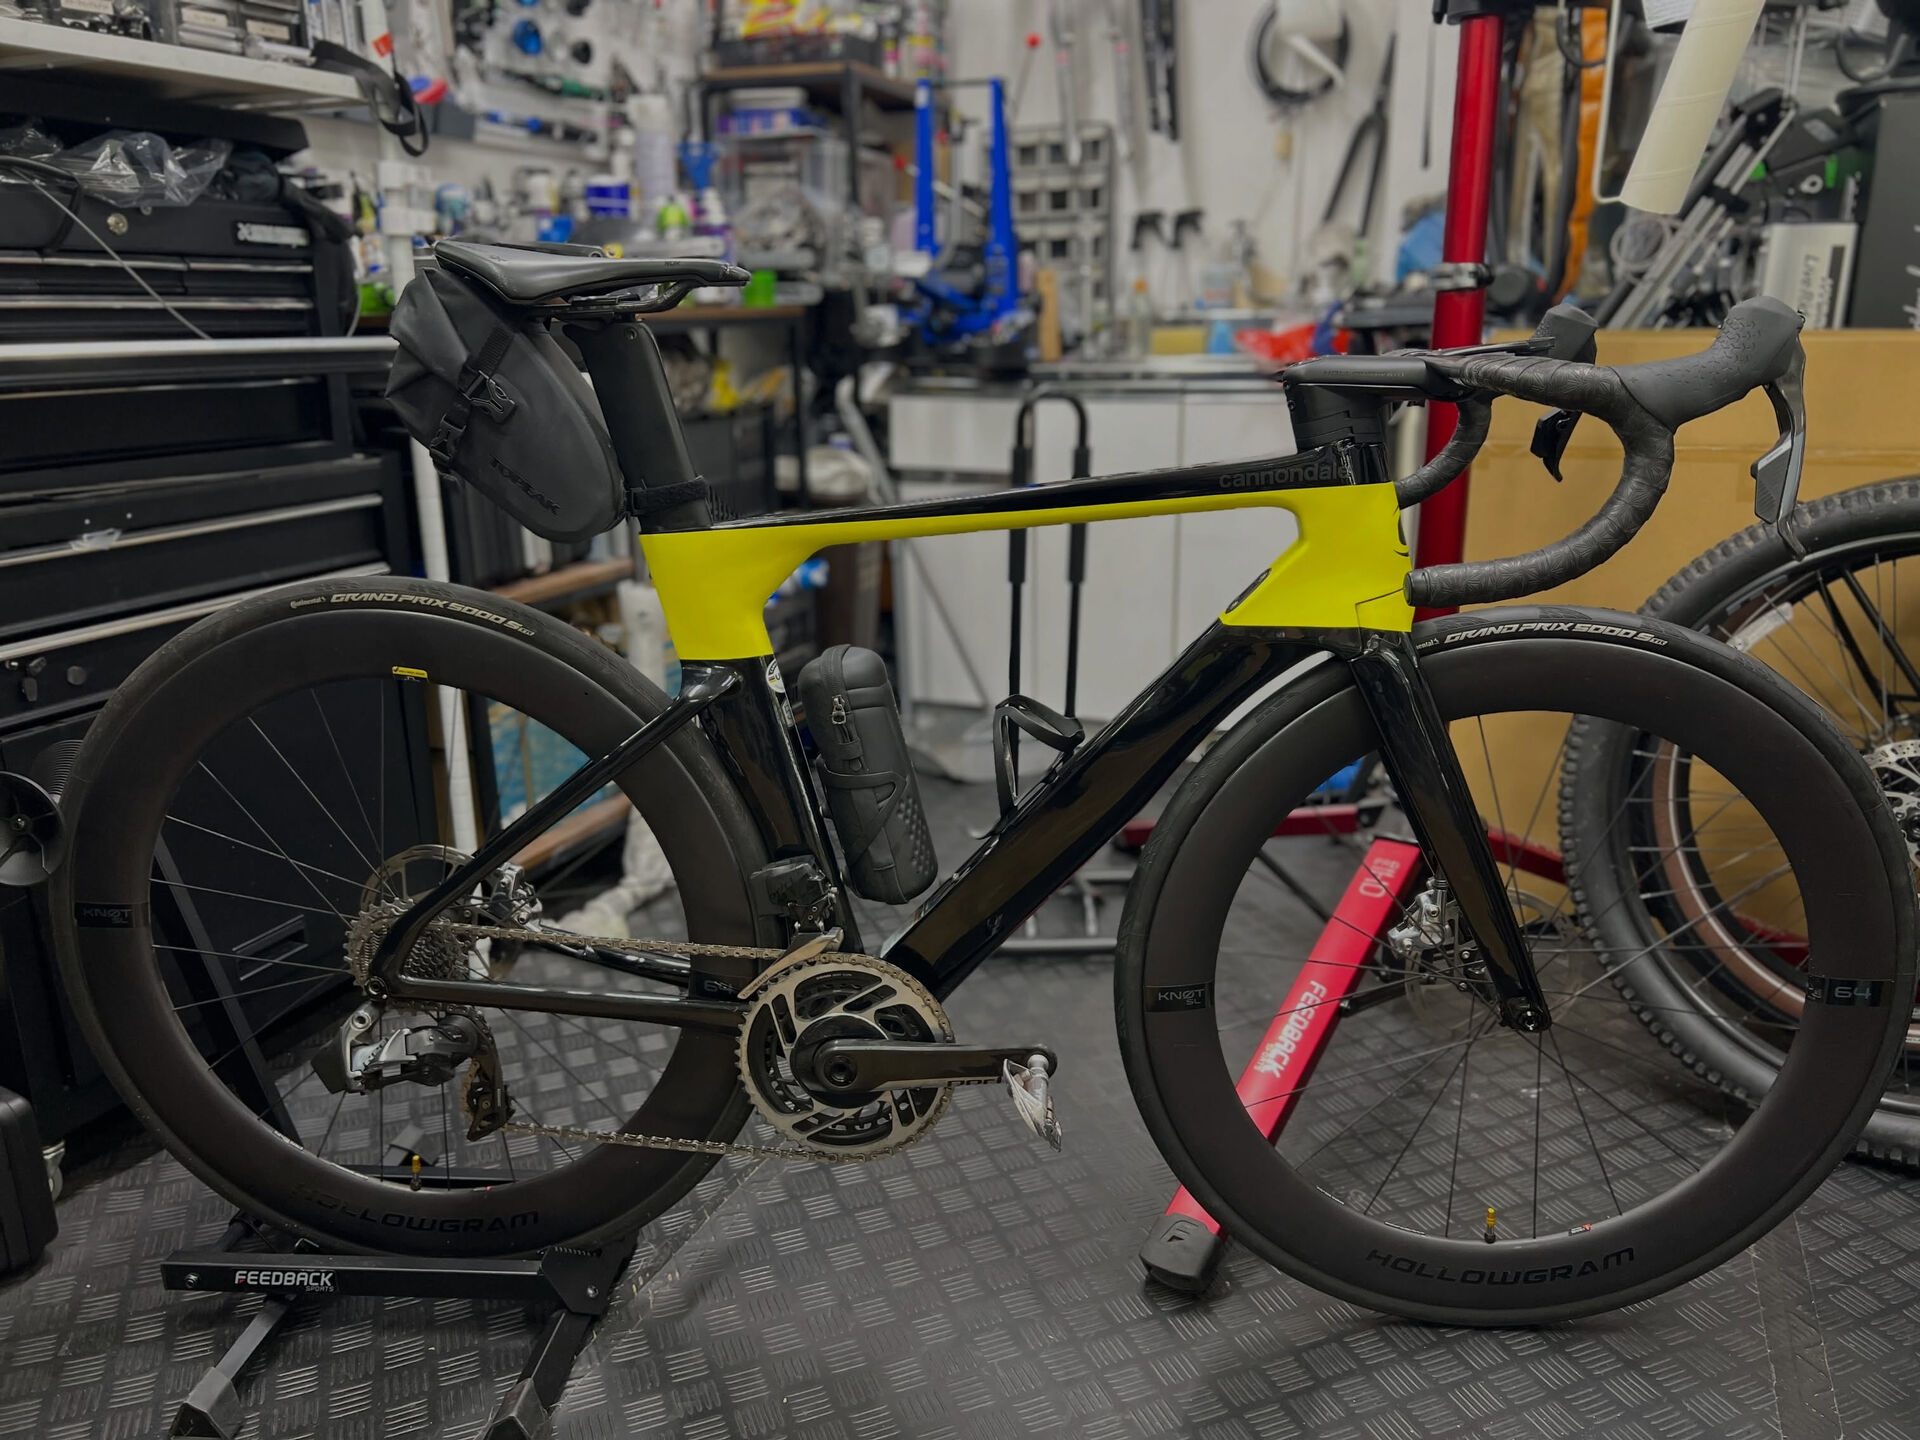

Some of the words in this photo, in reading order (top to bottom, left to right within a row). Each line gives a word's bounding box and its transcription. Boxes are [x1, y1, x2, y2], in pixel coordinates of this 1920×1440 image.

[1219, 460, 1349, 488] cannondale
[330, 593, 398, 603] GRAND
[398, 594, 449, 608] PRIX
[447, 602, 506, 624] 5000
[1444, 624, 1519, 644] GRAND
[1518, 622, 1574, 632] PRIX
[1572, 623, 1637, 639] 5000
[1834, 986, 1871, 1000] 64
[1364, 1247, 1635, 1286] HOLLOWGRAM
[235, 1270, 334, 1287] FEEDBACK
[305, 1285, 335, 1293] SPORTS
